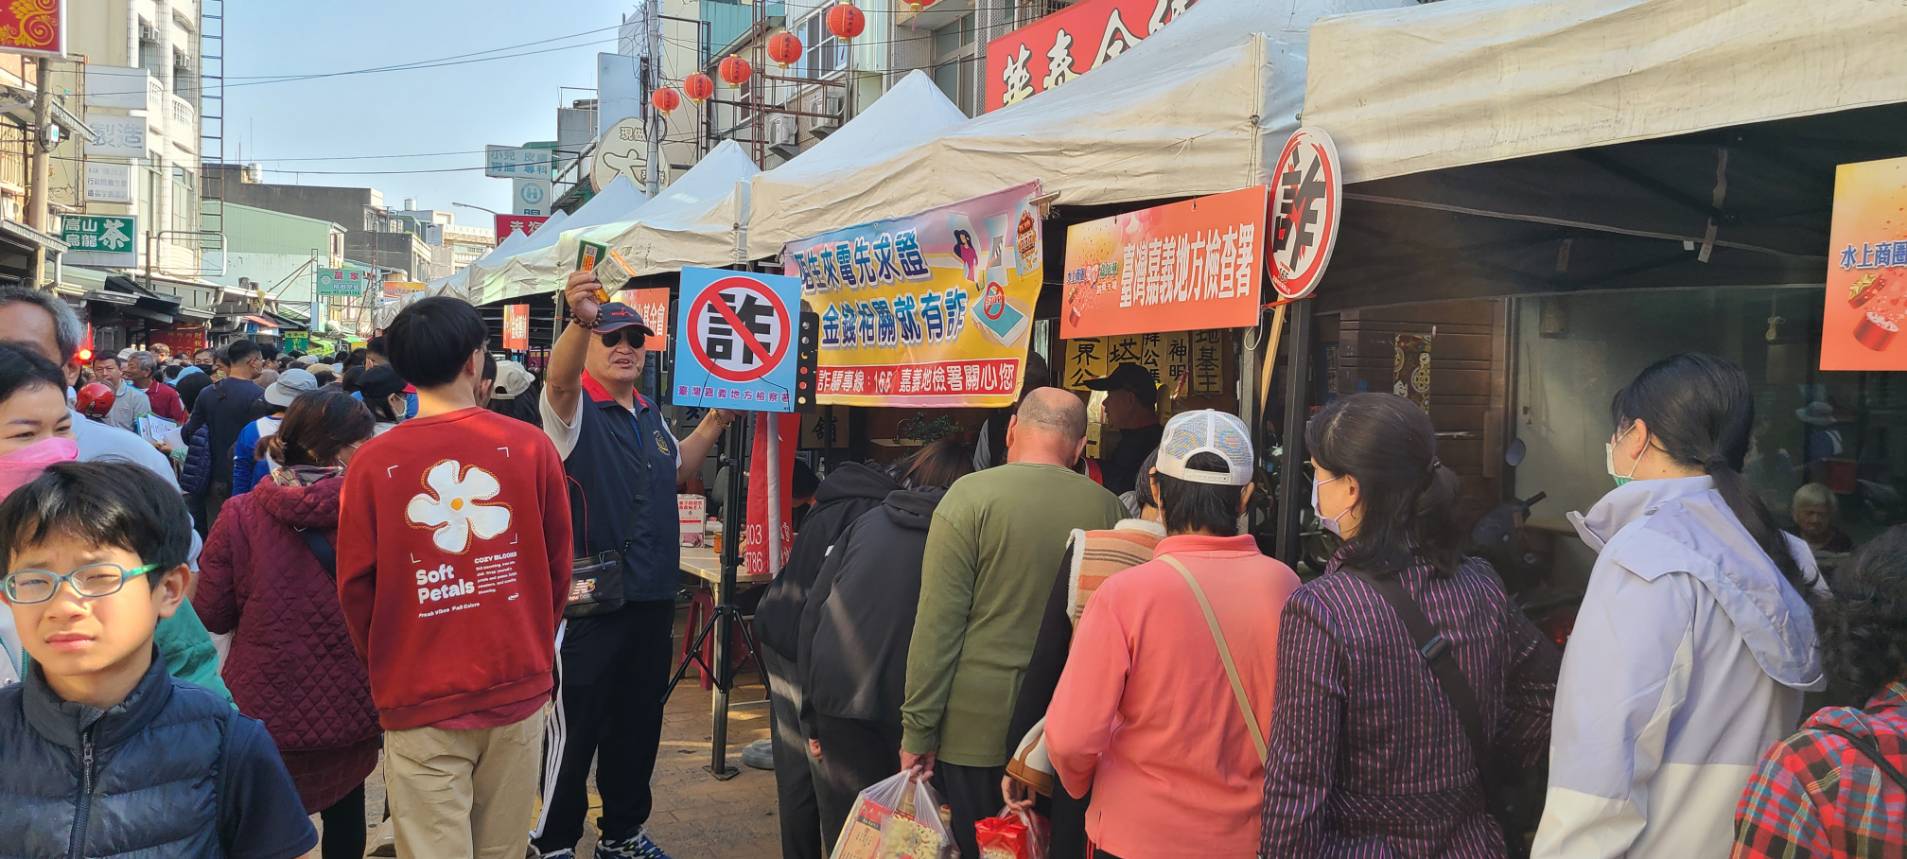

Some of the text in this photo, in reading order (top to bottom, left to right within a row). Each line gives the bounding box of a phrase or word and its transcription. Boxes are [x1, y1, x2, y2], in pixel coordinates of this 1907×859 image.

[98, 219, 130, 250] 茶
[706, 293, 774, 365] 詐
[821, 289, 968, 346] 金錢相關就有詐
[1071, 337, 1101, 387] 界公
[416, 563, 455, 586] Soft
[417, 578, 475, 604] Petals
